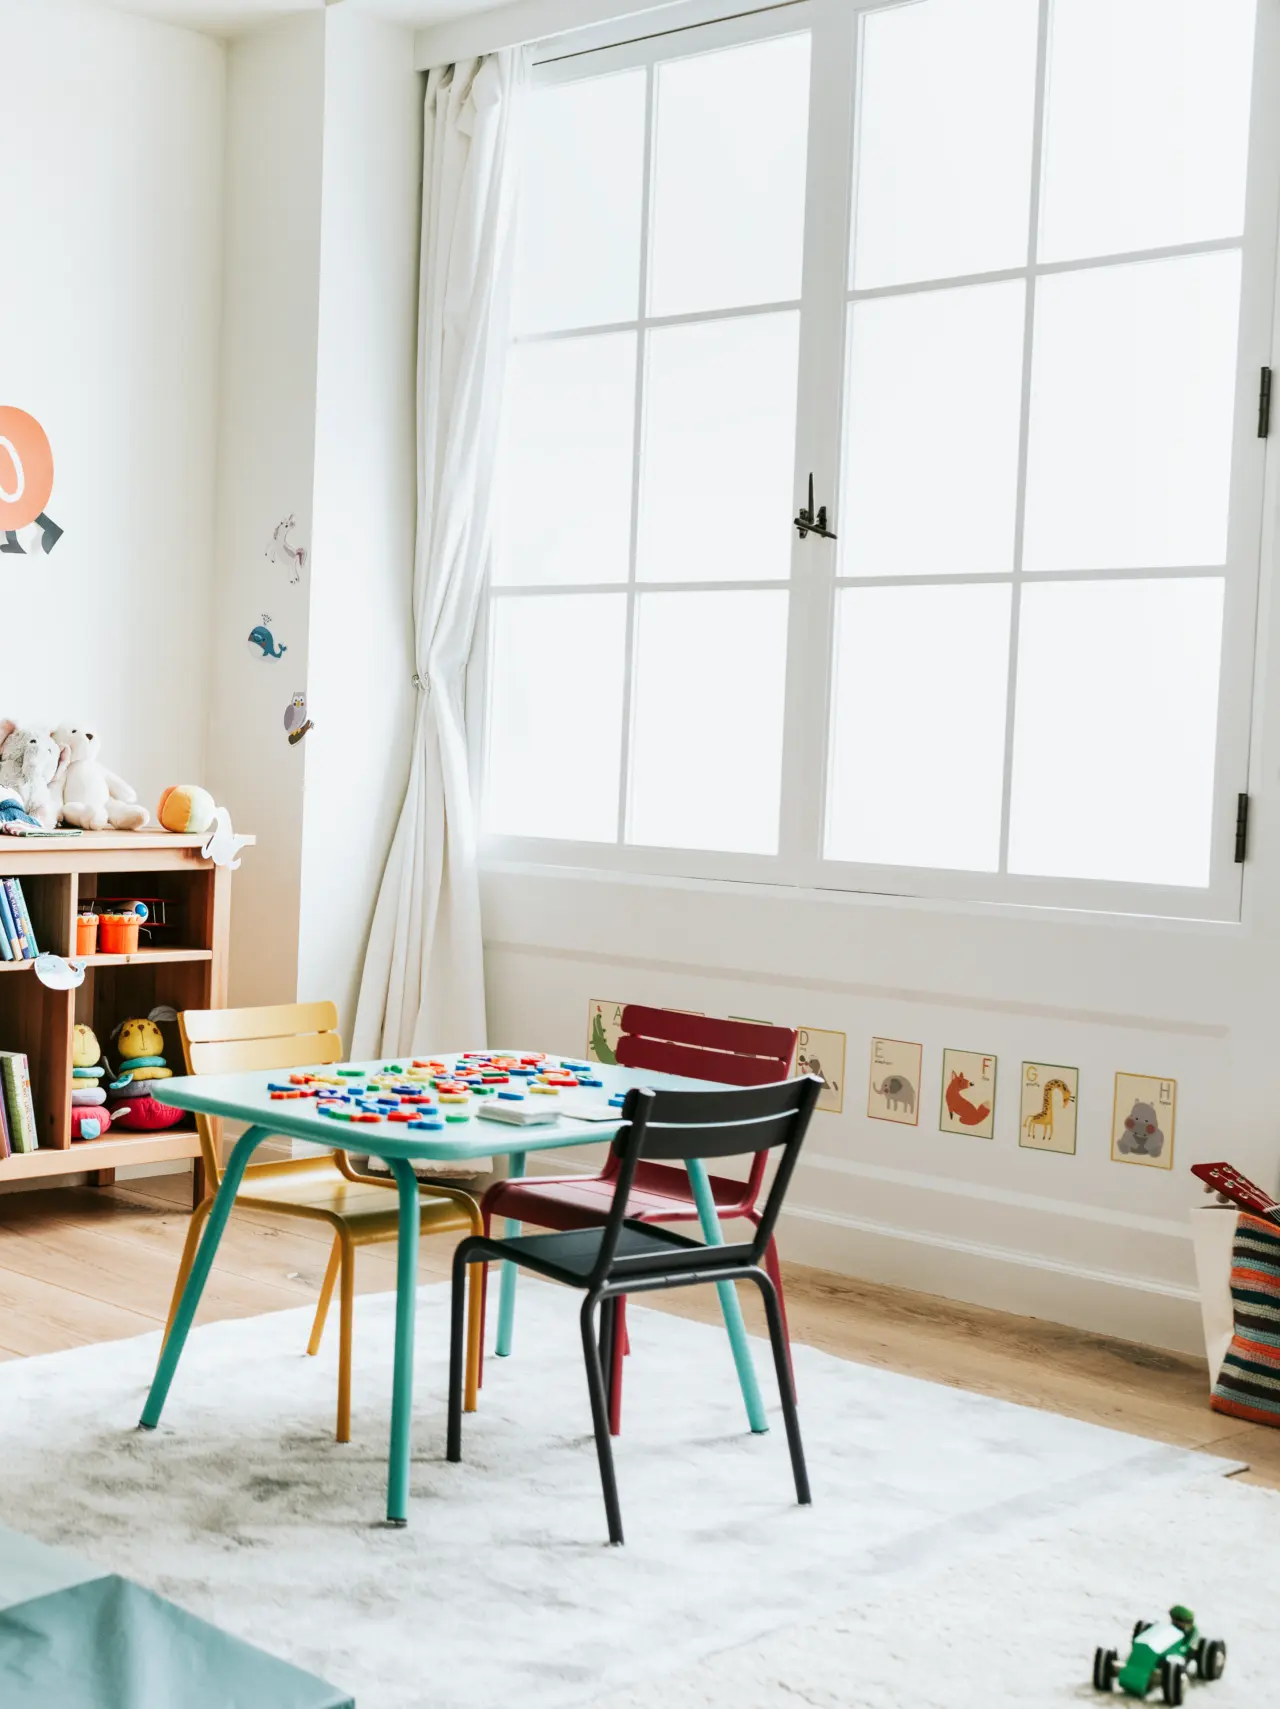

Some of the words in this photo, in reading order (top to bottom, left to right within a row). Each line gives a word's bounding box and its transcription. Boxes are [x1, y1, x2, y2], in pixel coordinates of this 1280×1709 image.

[613, 1006, 621, 1021] A
[799, 1030, 809, 1046] D
[874, 1041, 885, 1058] E
[982, 1057, 992, 1074] F
[1026, 1065, 1038, 1082] G
[1159, 1082, 1171, 1100] H
